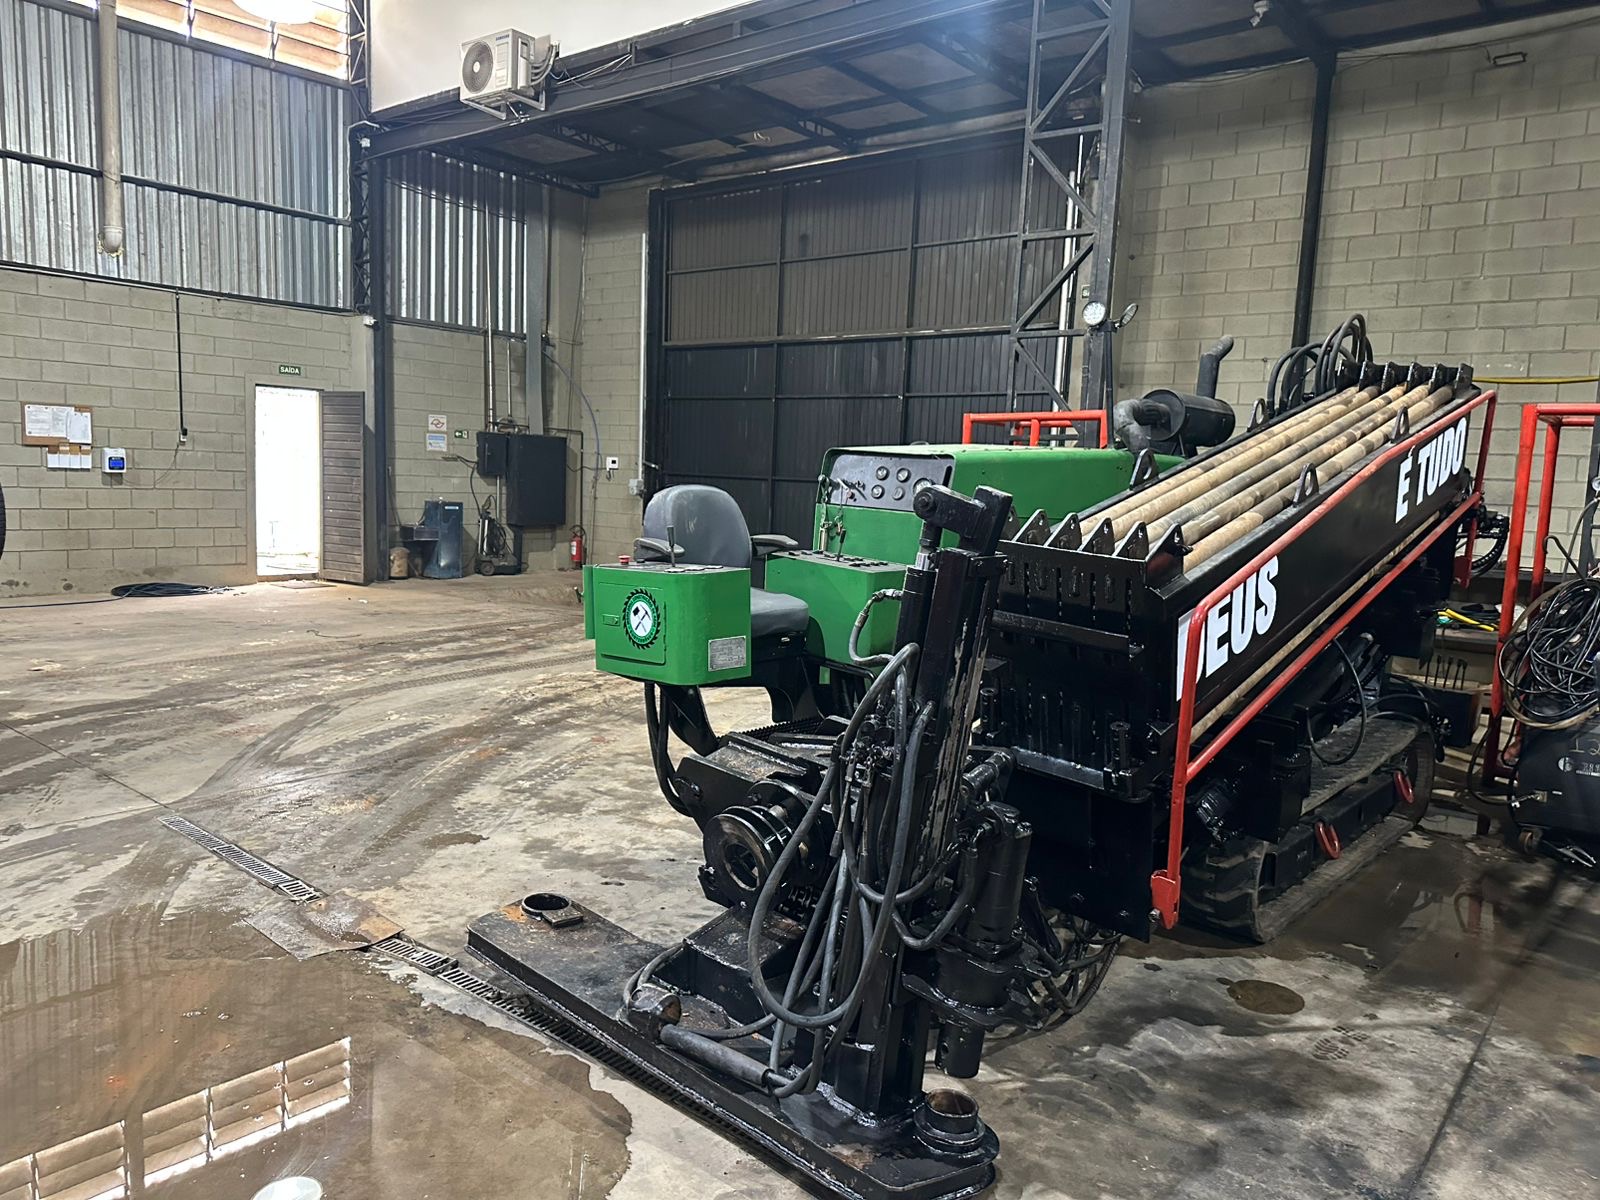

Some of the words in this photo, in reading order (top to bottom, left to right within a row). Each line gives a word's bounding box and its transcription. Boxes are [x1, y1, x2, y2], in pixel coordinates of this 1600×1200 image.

[280, 366, 300, 374] SAÍDA
[1395, 445, 1416, 524] É
[1416, 417, 1467, 506] TUDO
